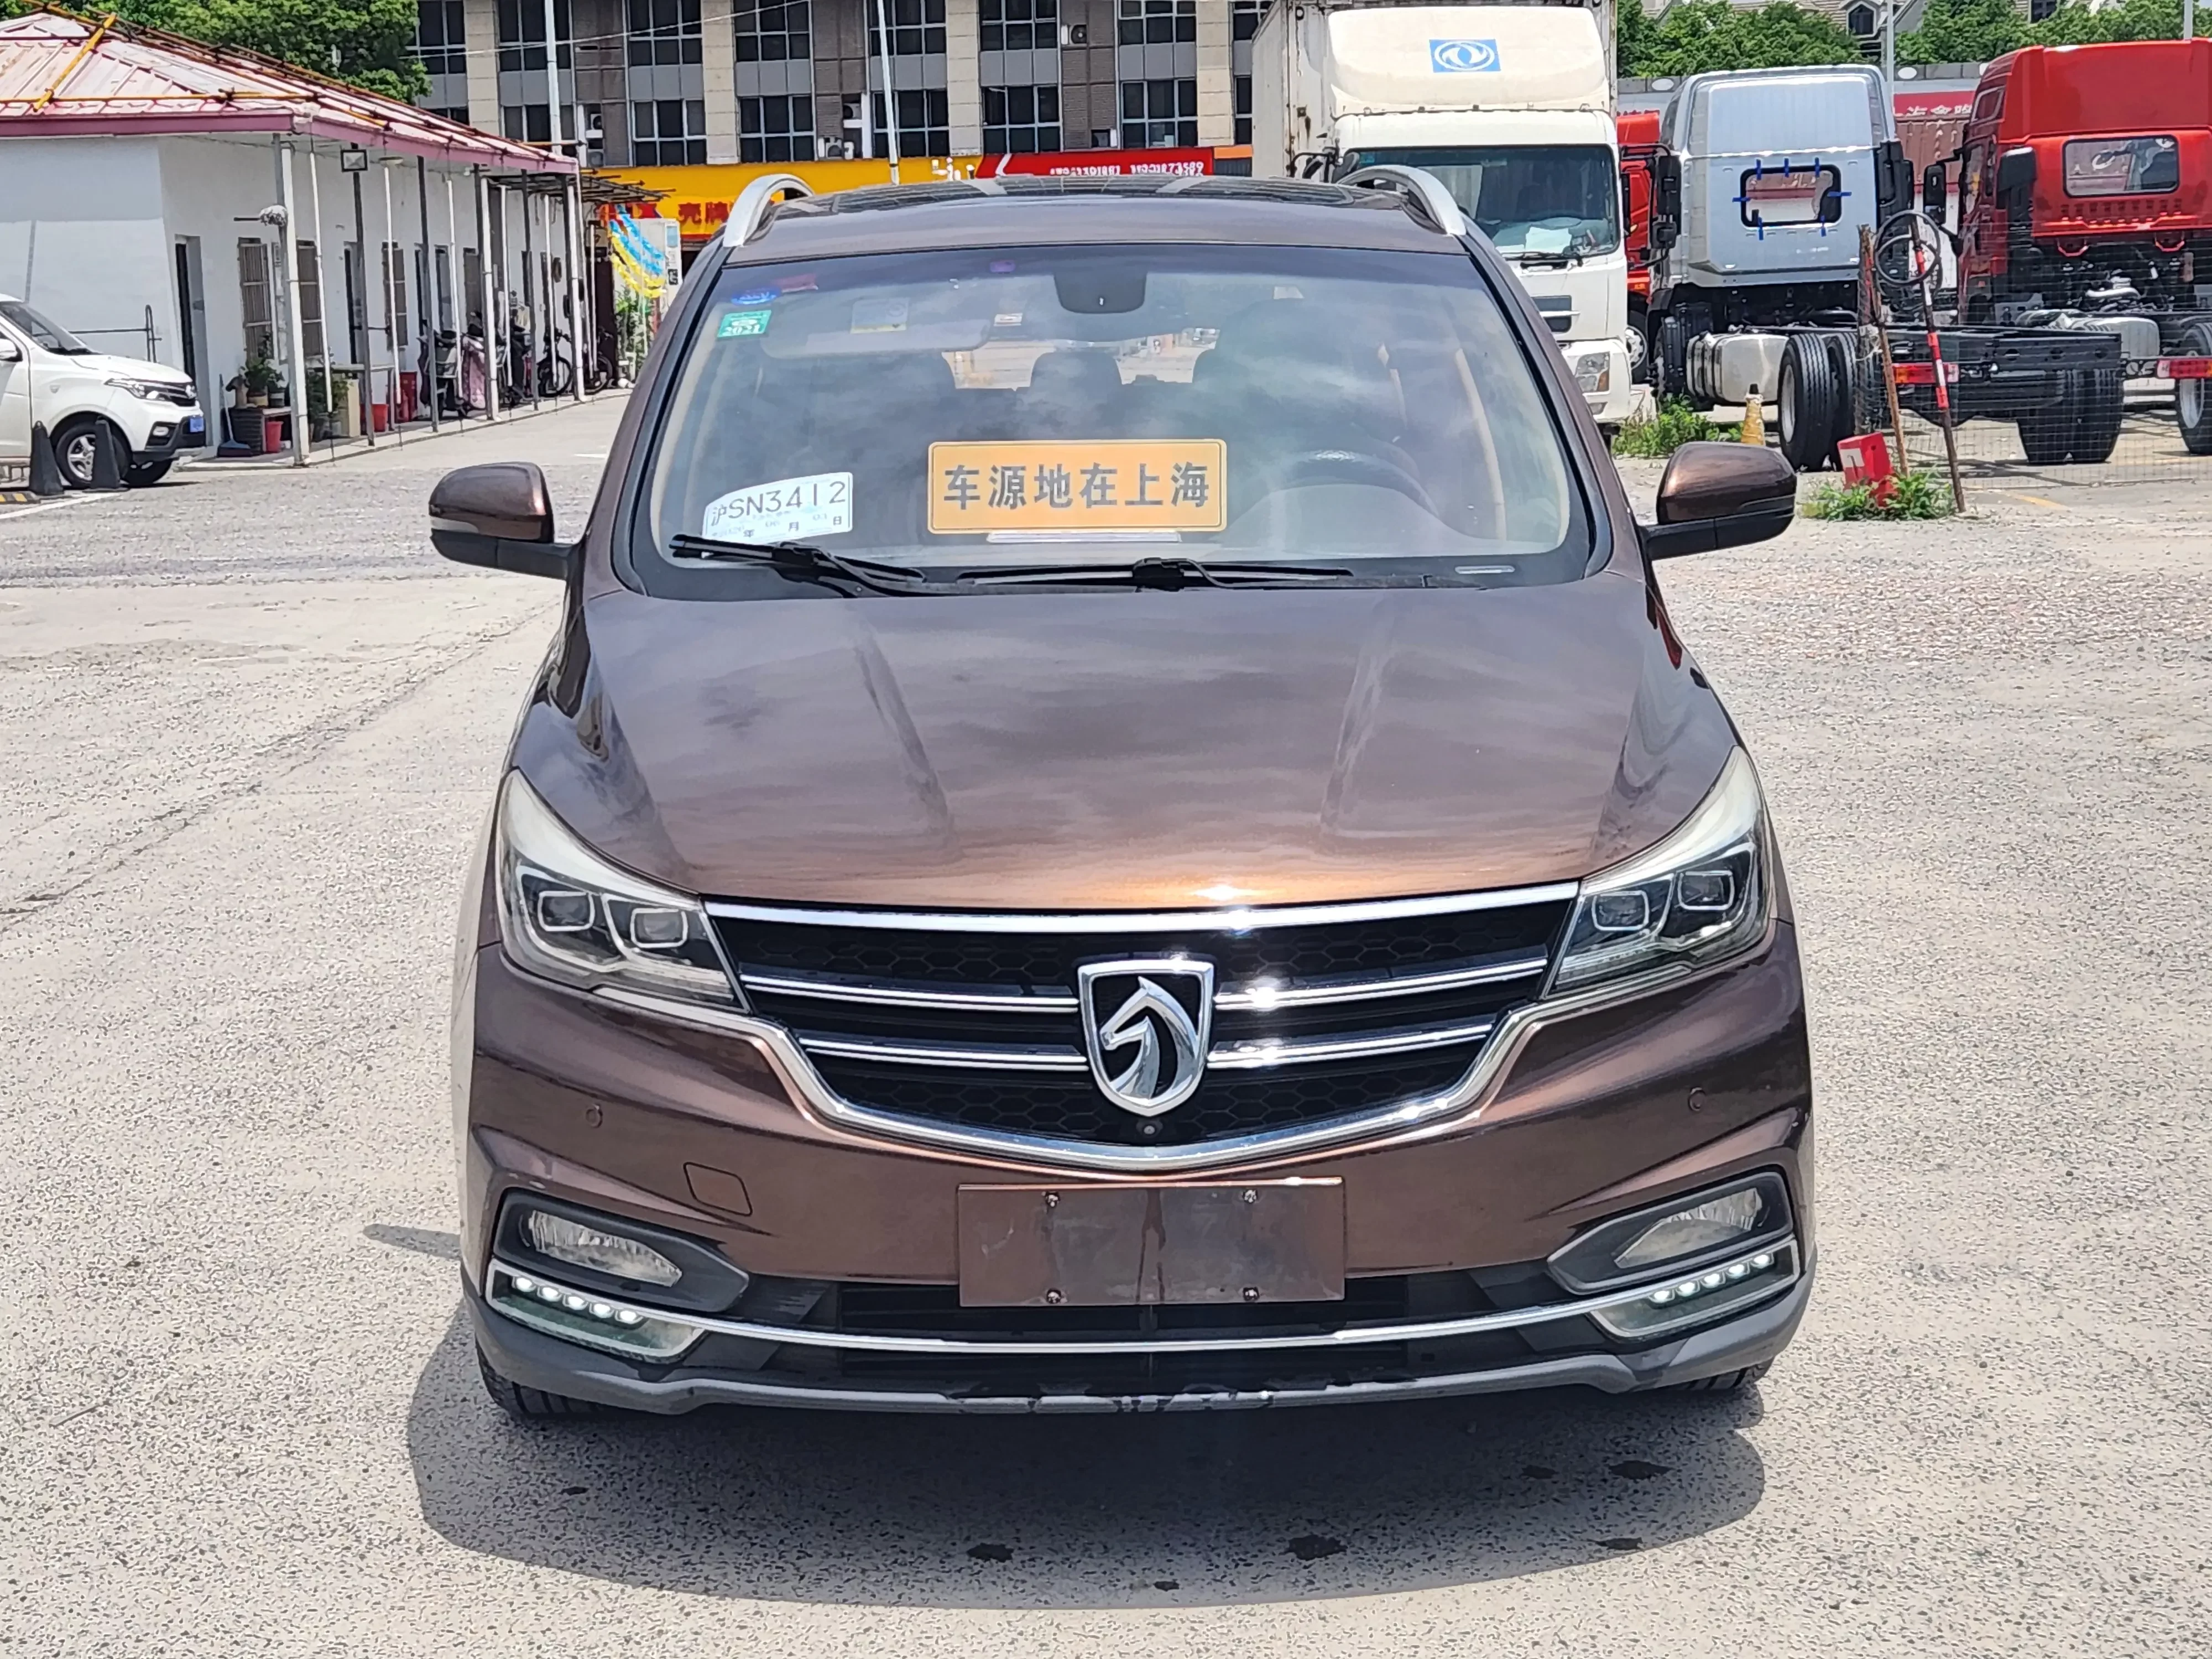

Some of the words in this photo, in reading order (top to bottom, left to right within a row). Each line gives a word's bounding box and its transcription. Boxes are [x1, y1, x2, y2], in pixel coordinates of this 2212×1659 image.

[711, 481, 846, 526] 沪SN3412
[943, 462, 1209, 510] 车源地在上海
